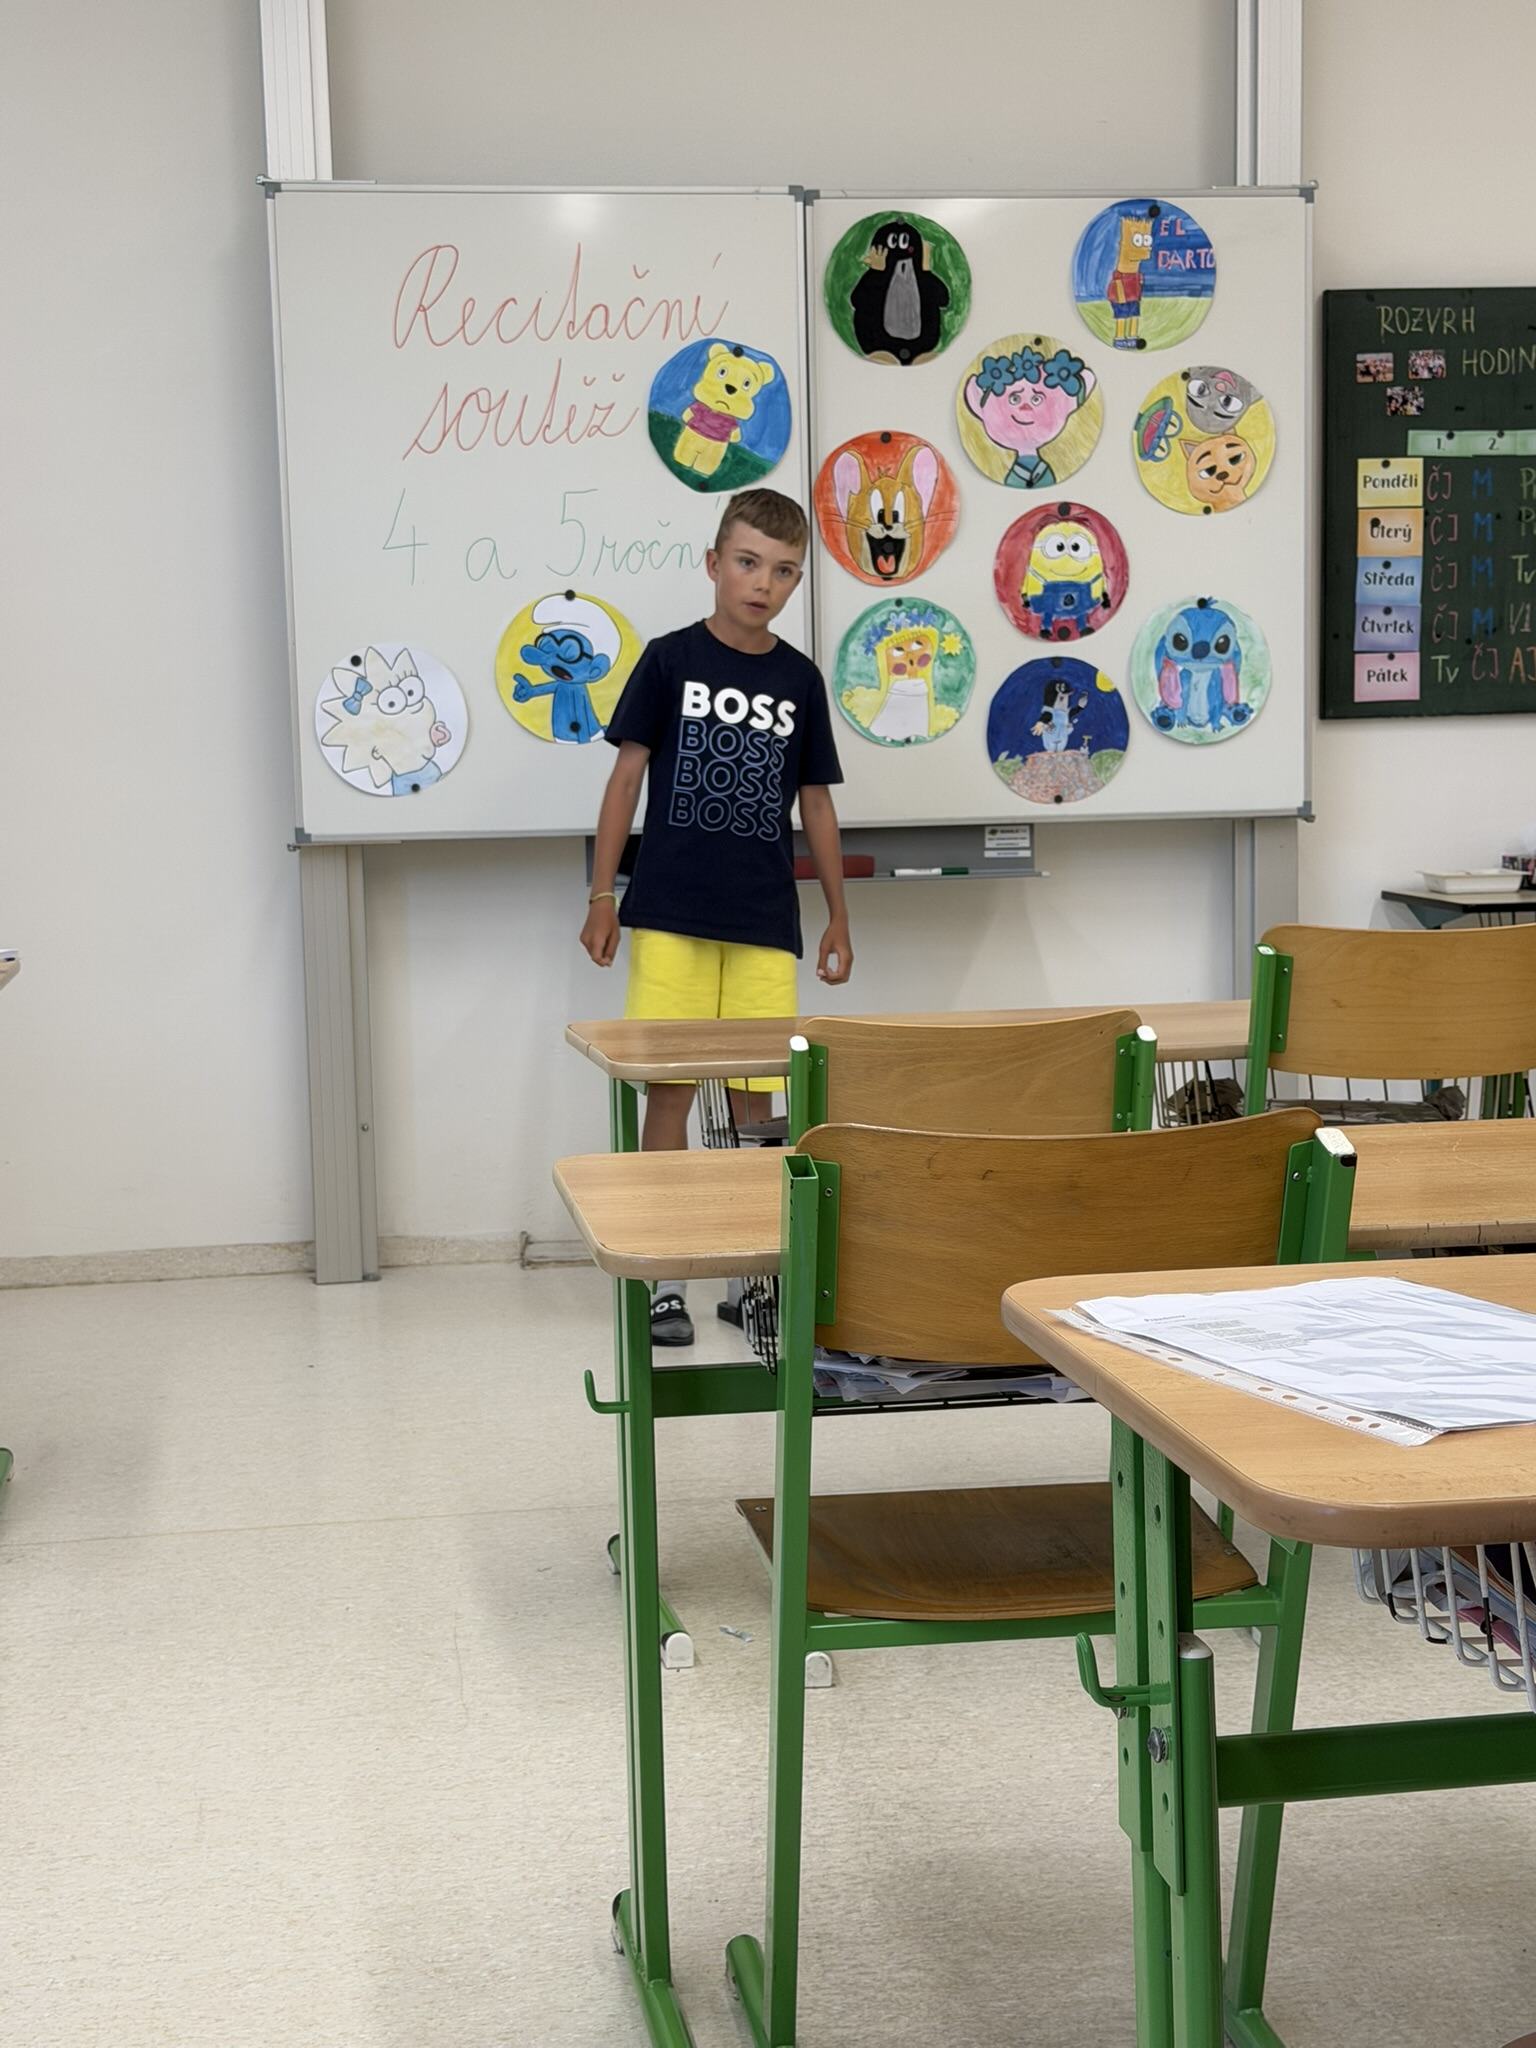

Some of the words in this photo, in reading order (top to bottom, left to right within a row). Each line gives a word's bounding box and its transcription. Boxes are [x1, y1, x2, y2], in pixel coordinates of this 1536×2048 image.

[394, 242, 729, 349] Recitační
[1378, 305, 1475, 341] ROZVRH
[403, 358, 639, 461] soutěž
[1363, 474, 1418, 489] Pondělí
[1427, 465, 1452, 501] ČJ
[1472, 467, 1493, 497] M
[1520, 467, 1536, 499] P
[382, 488, 430, 586] 4
[465, 537, 518, 581] a
[1430, 508, 1458, 545] ČJ
[1473, 511, 1494, 543] M
[1364, 571, 1415, 587] Středa
[1431, 556, 1458, 592] ČJ
[1472, 555, 1494, 587] M
[1511, 554, 1536, 584] Tv
[1361, 616, 1414, 633] Čtvrtek
[1432, 603, 1459, 643] ČJ
[1472, 607, 1494, 638] M
[1367, 668, 1408, 683] Pátek
[1430, 655, 1459, 683] Tv
[1472, 643, 1499, 681] ČJ
[682, 680, 797, 737] BOSS
[678, 717, 788, 773] BOSS
[673, 753, 782, 807] BOSS
[668, 789, 781, 841] BOSS
